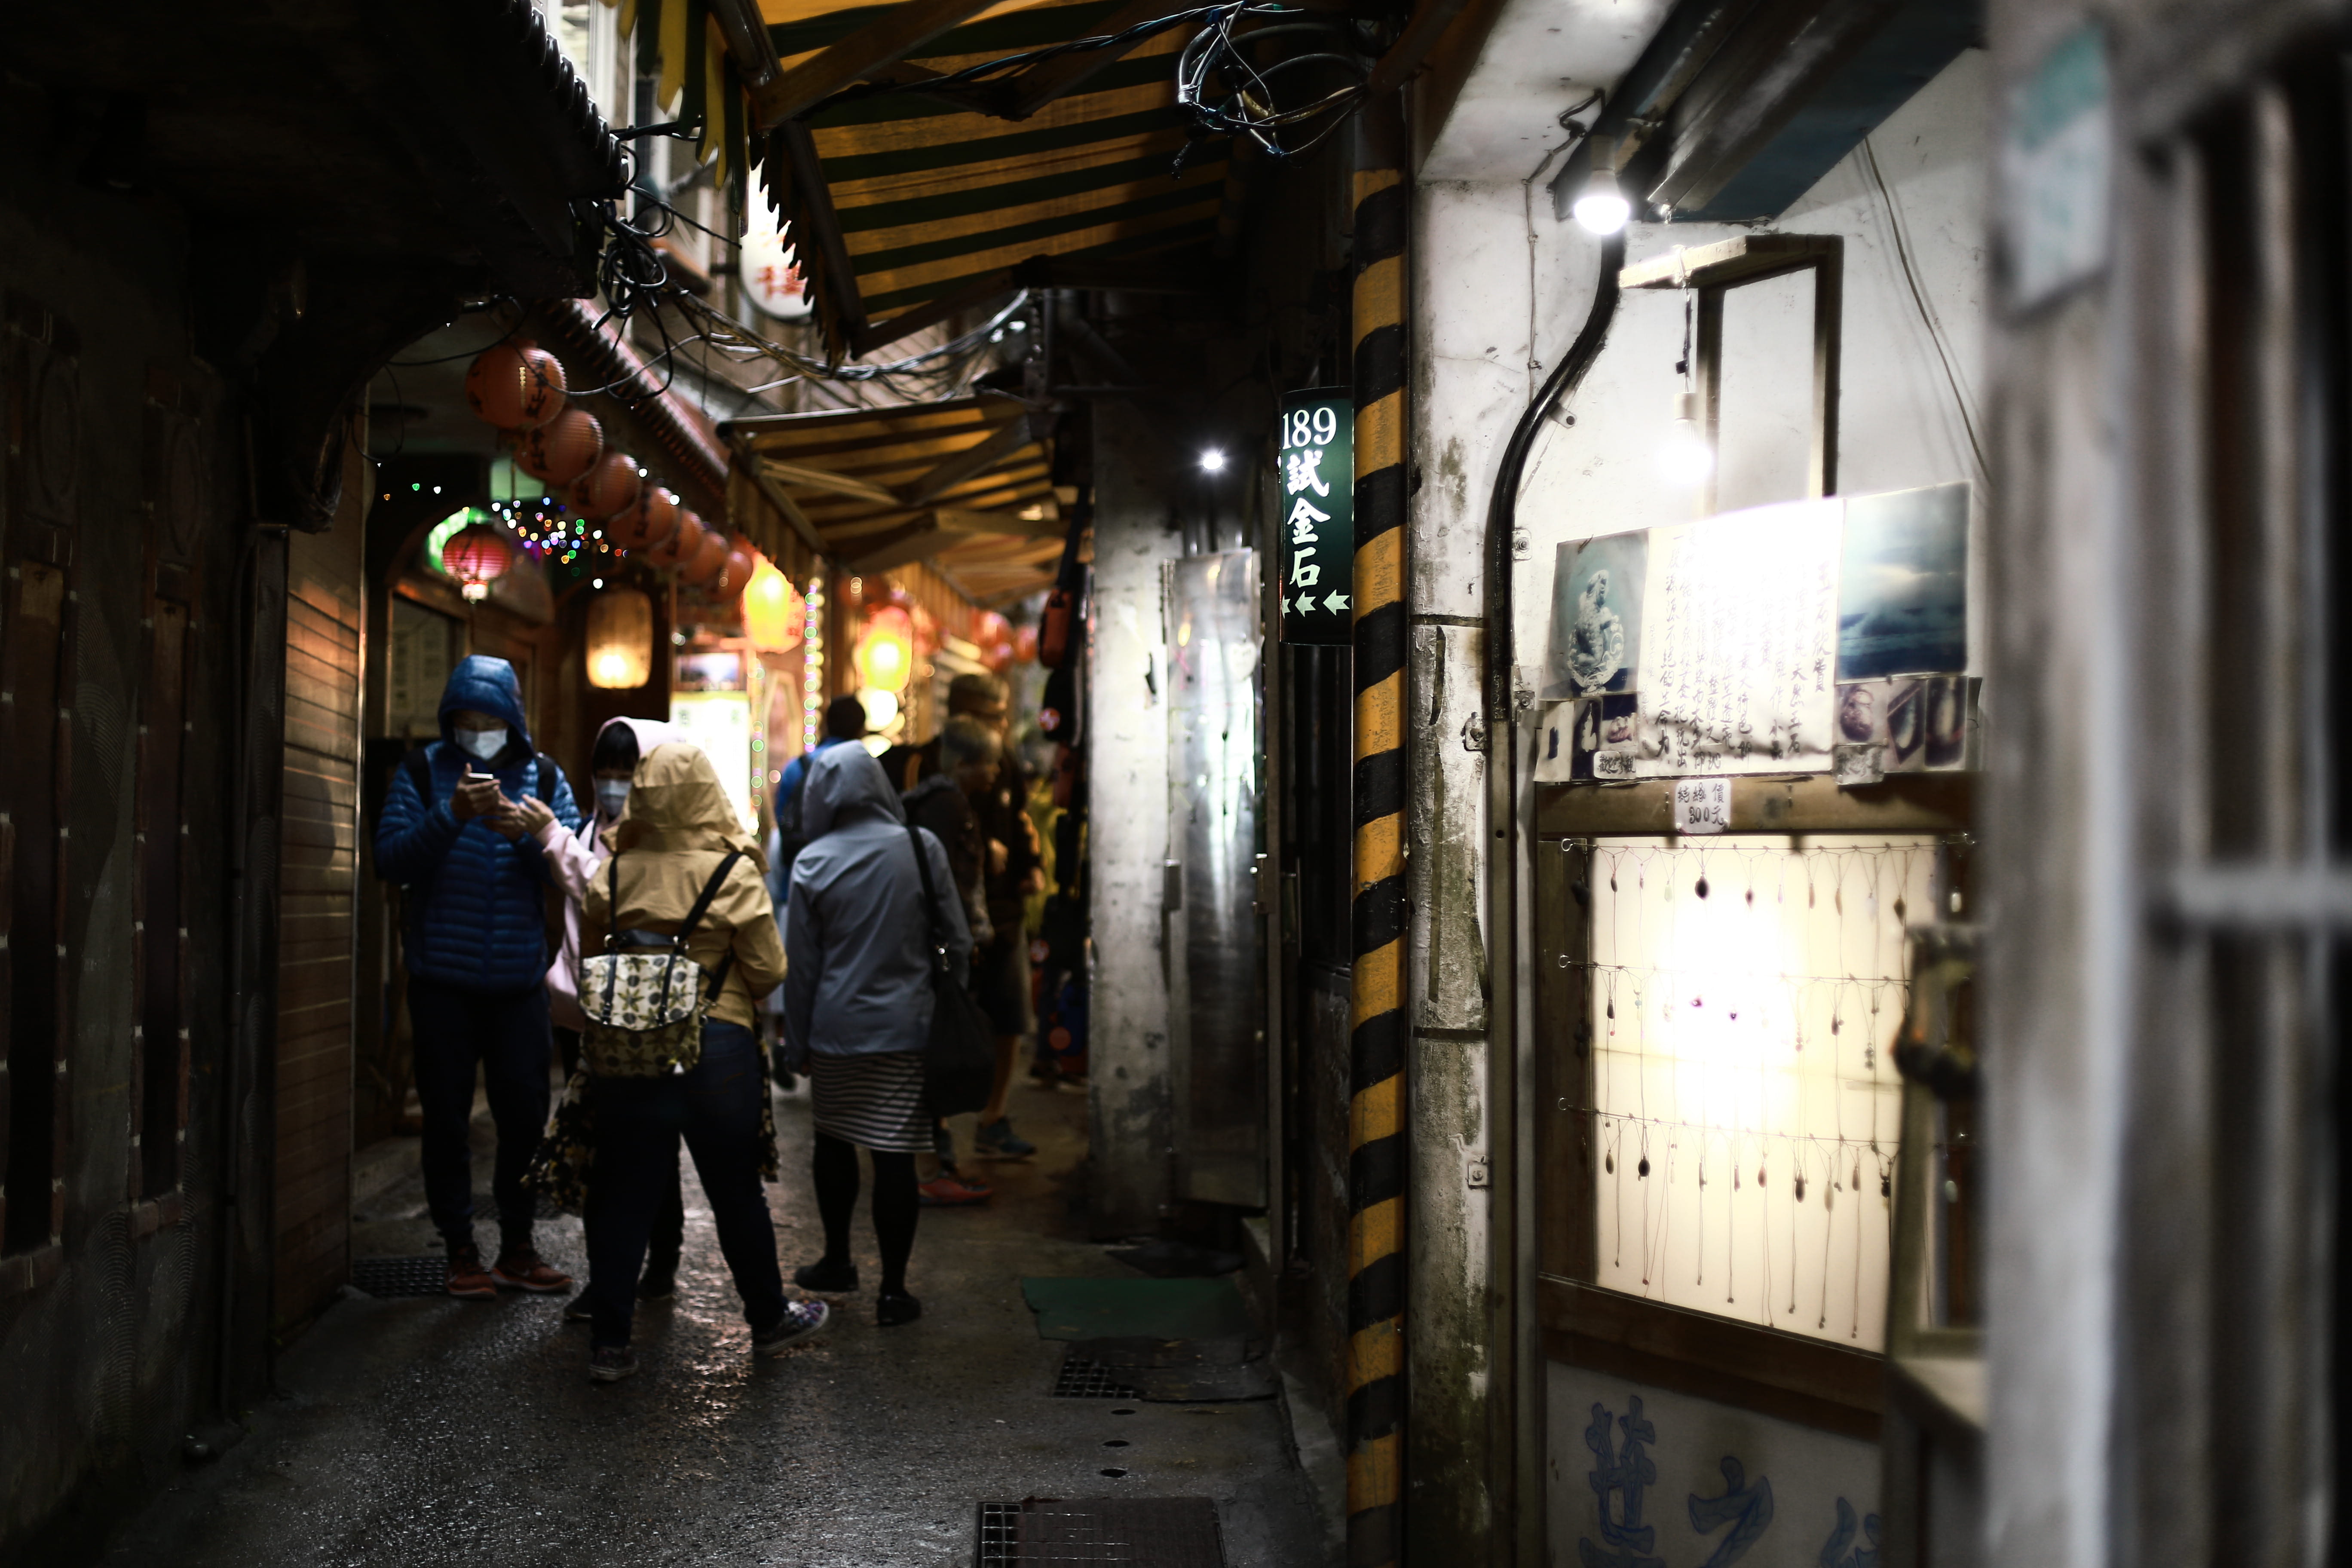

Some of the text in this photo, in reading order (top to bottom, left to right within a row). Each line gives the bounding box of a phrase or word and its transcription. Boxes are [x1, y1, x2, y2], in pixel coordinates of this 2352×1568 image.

[1283, 407, 1336, 450] 189
[1286, 449, 1331, 588] 試金石
[1689, 805, 1724, 825] 300元
